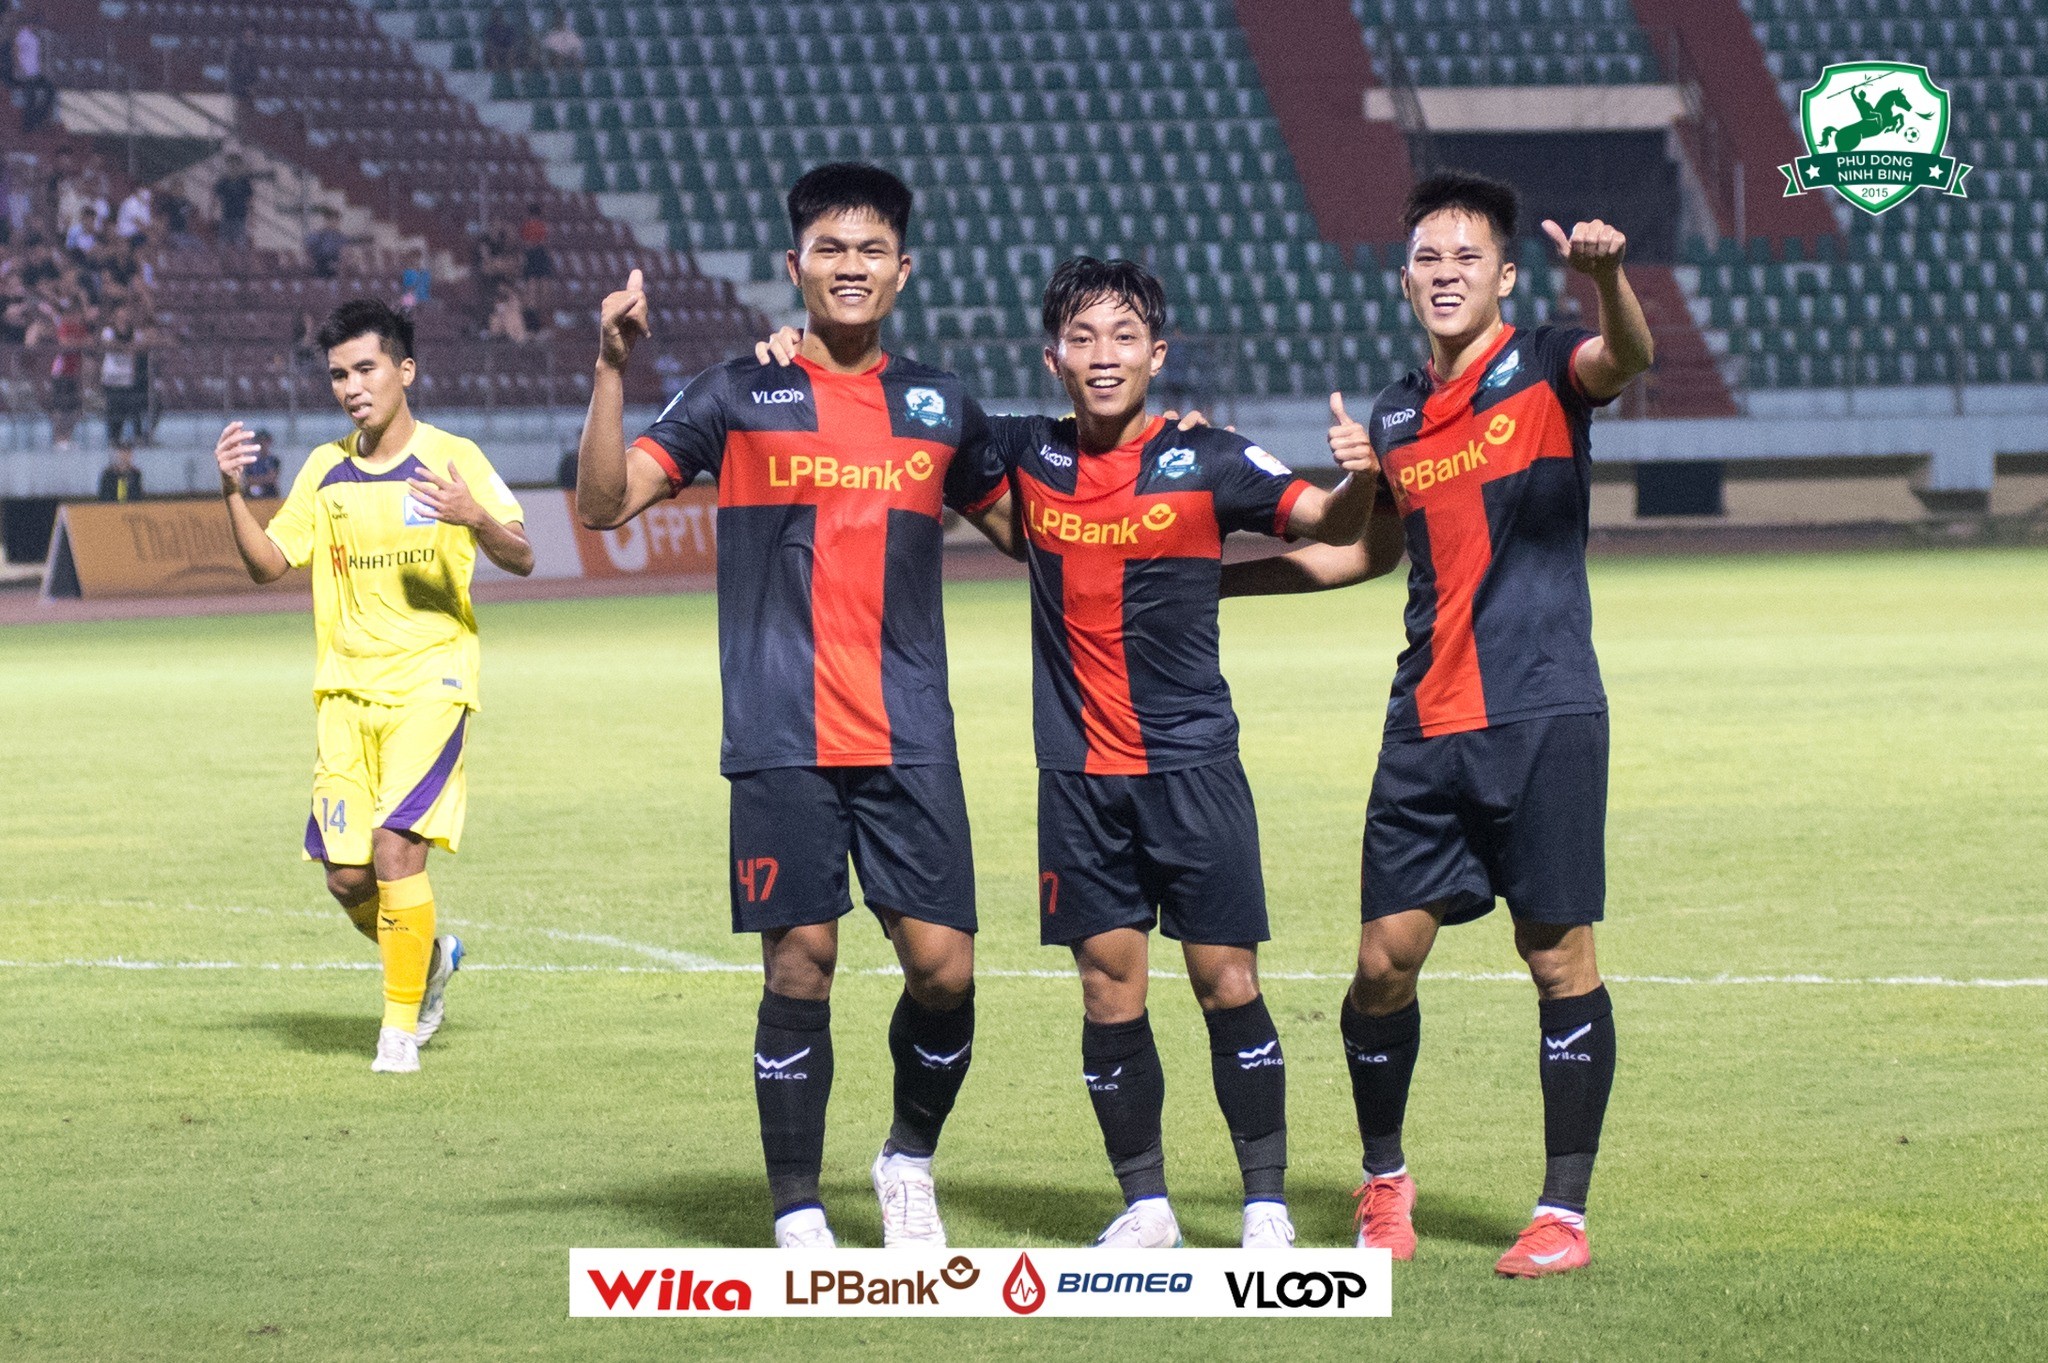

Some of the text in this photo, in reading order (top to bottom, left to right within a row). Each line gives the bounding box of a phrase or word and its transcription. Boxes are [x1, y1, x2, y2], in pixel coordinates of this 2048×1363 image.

[751, 388, 805, 404] VLOOP
[1381, 408, 1416, 430] VLOOP
[768, 455, 904, 492] LPBank
[645, 505, 707, 556] FPT
[1030, 500, 1141, 545] LPBank
[348, 548, 435, 570] KHATOCO
[322, 797, 347, 834] 14
[737, 856, 779, 902] 47
